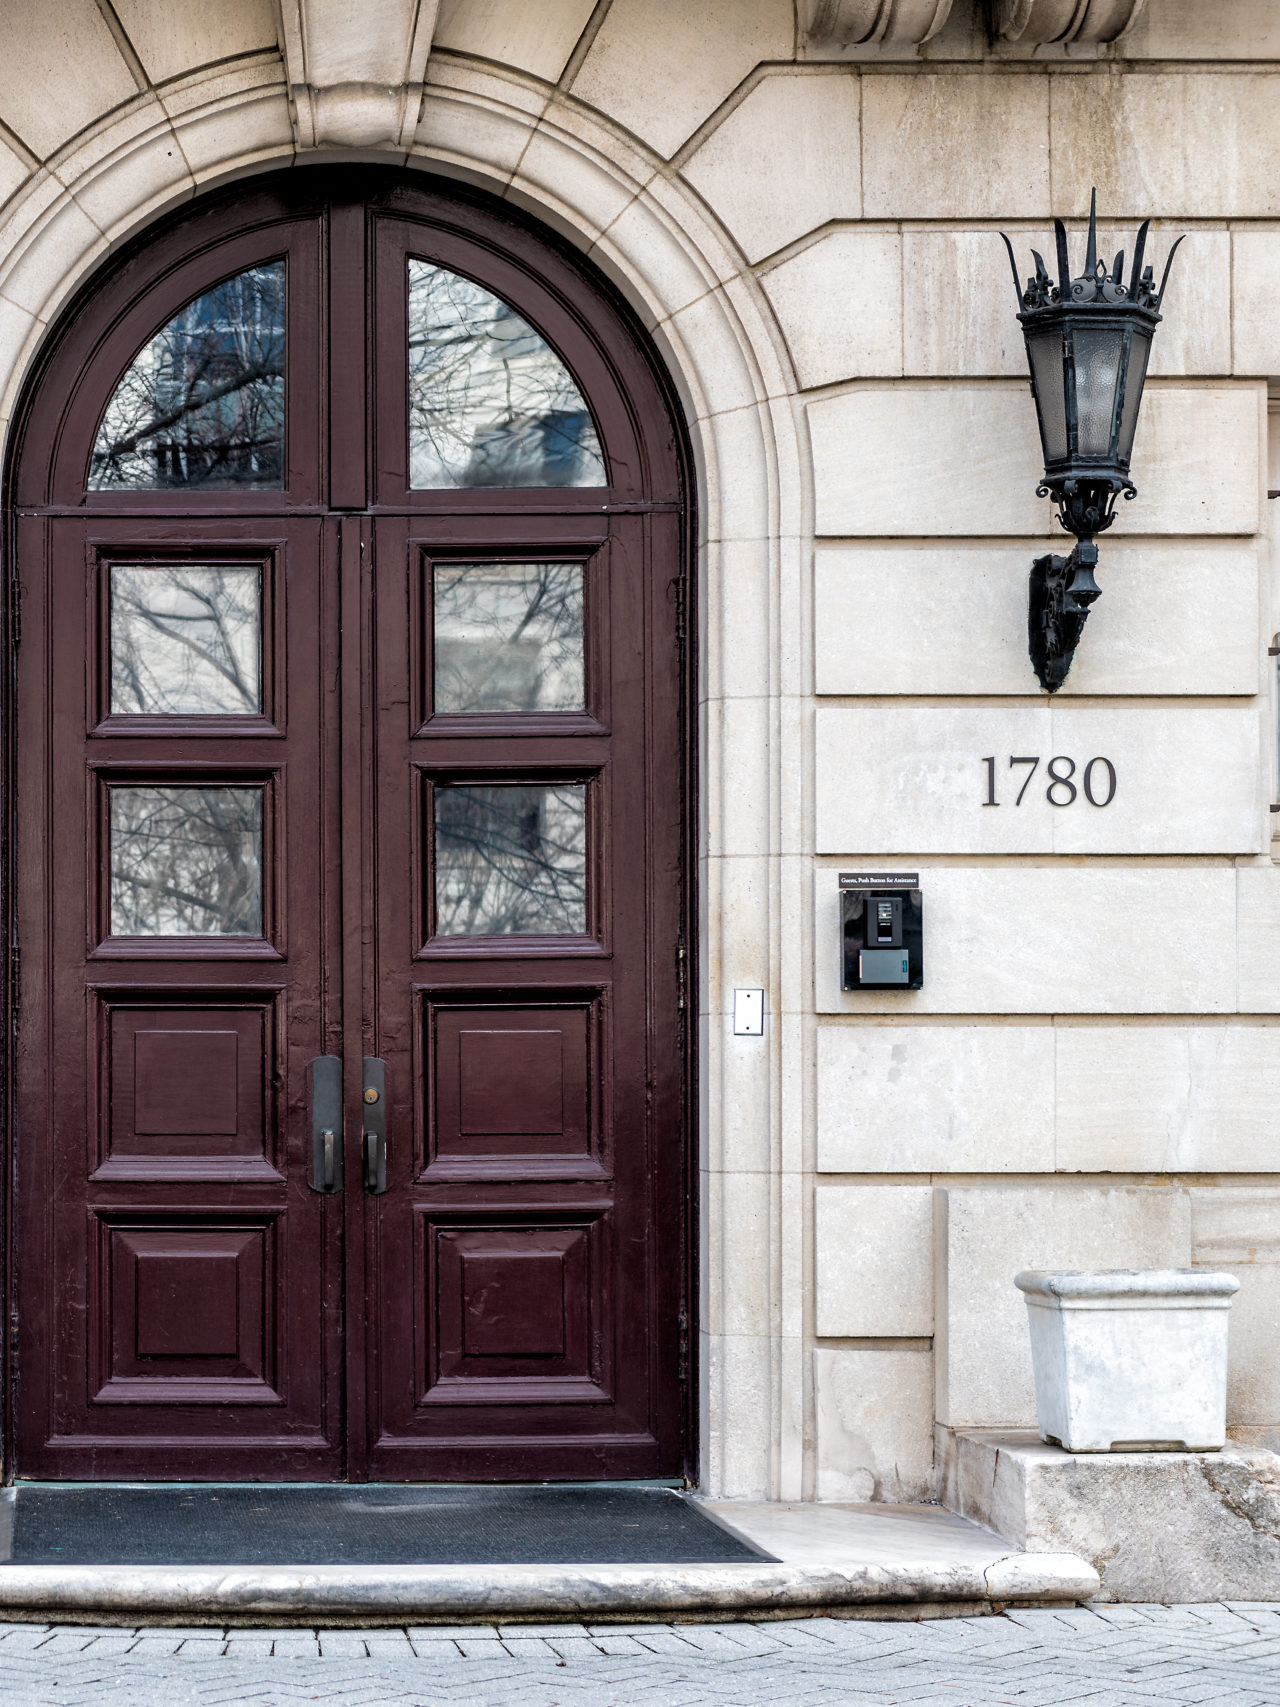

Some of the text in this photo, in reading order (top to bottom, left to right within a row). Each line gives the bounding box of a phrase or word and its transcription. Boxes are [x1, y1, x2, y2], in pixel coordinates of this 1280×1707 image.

[981, 755, 1117, 808] 1780
[858, 876, 870, 884] Push
[886, 876, 894, 884] for
